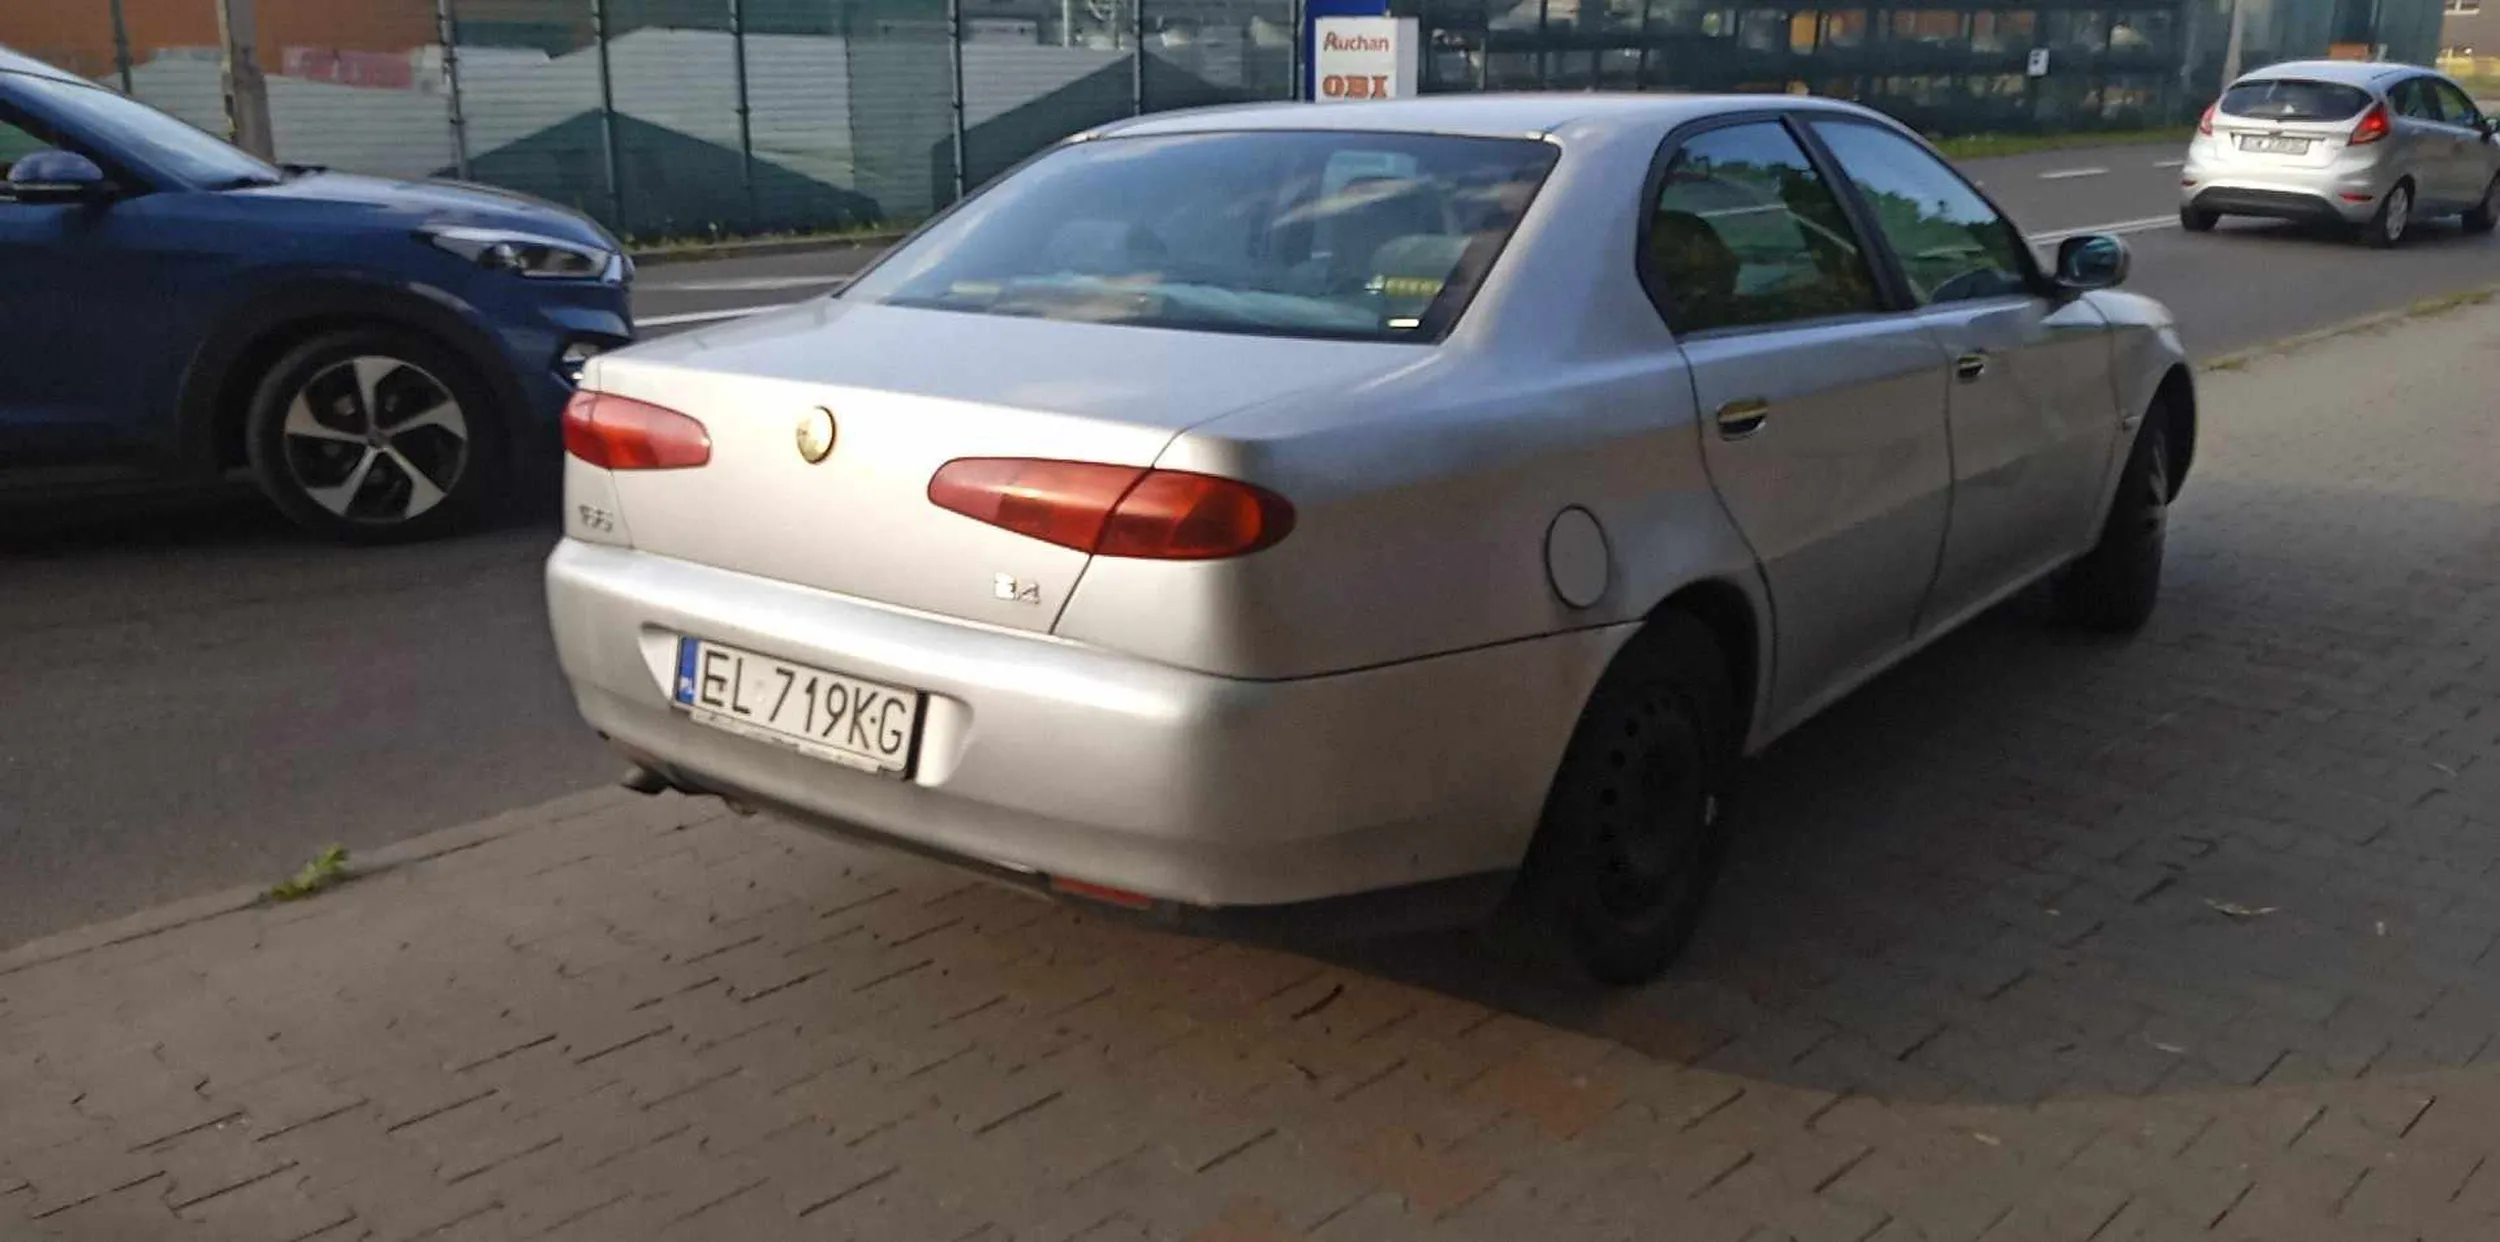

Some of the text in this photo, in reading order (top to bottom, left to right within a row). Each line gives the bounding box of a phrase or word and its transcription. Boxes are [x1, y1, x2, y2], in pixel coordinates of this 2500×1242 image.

[1323, 31, 1389, 51] Auchan
[1322, 75, 1388, 98] OBI
[701, 650, 906, 754] EL 719KG
